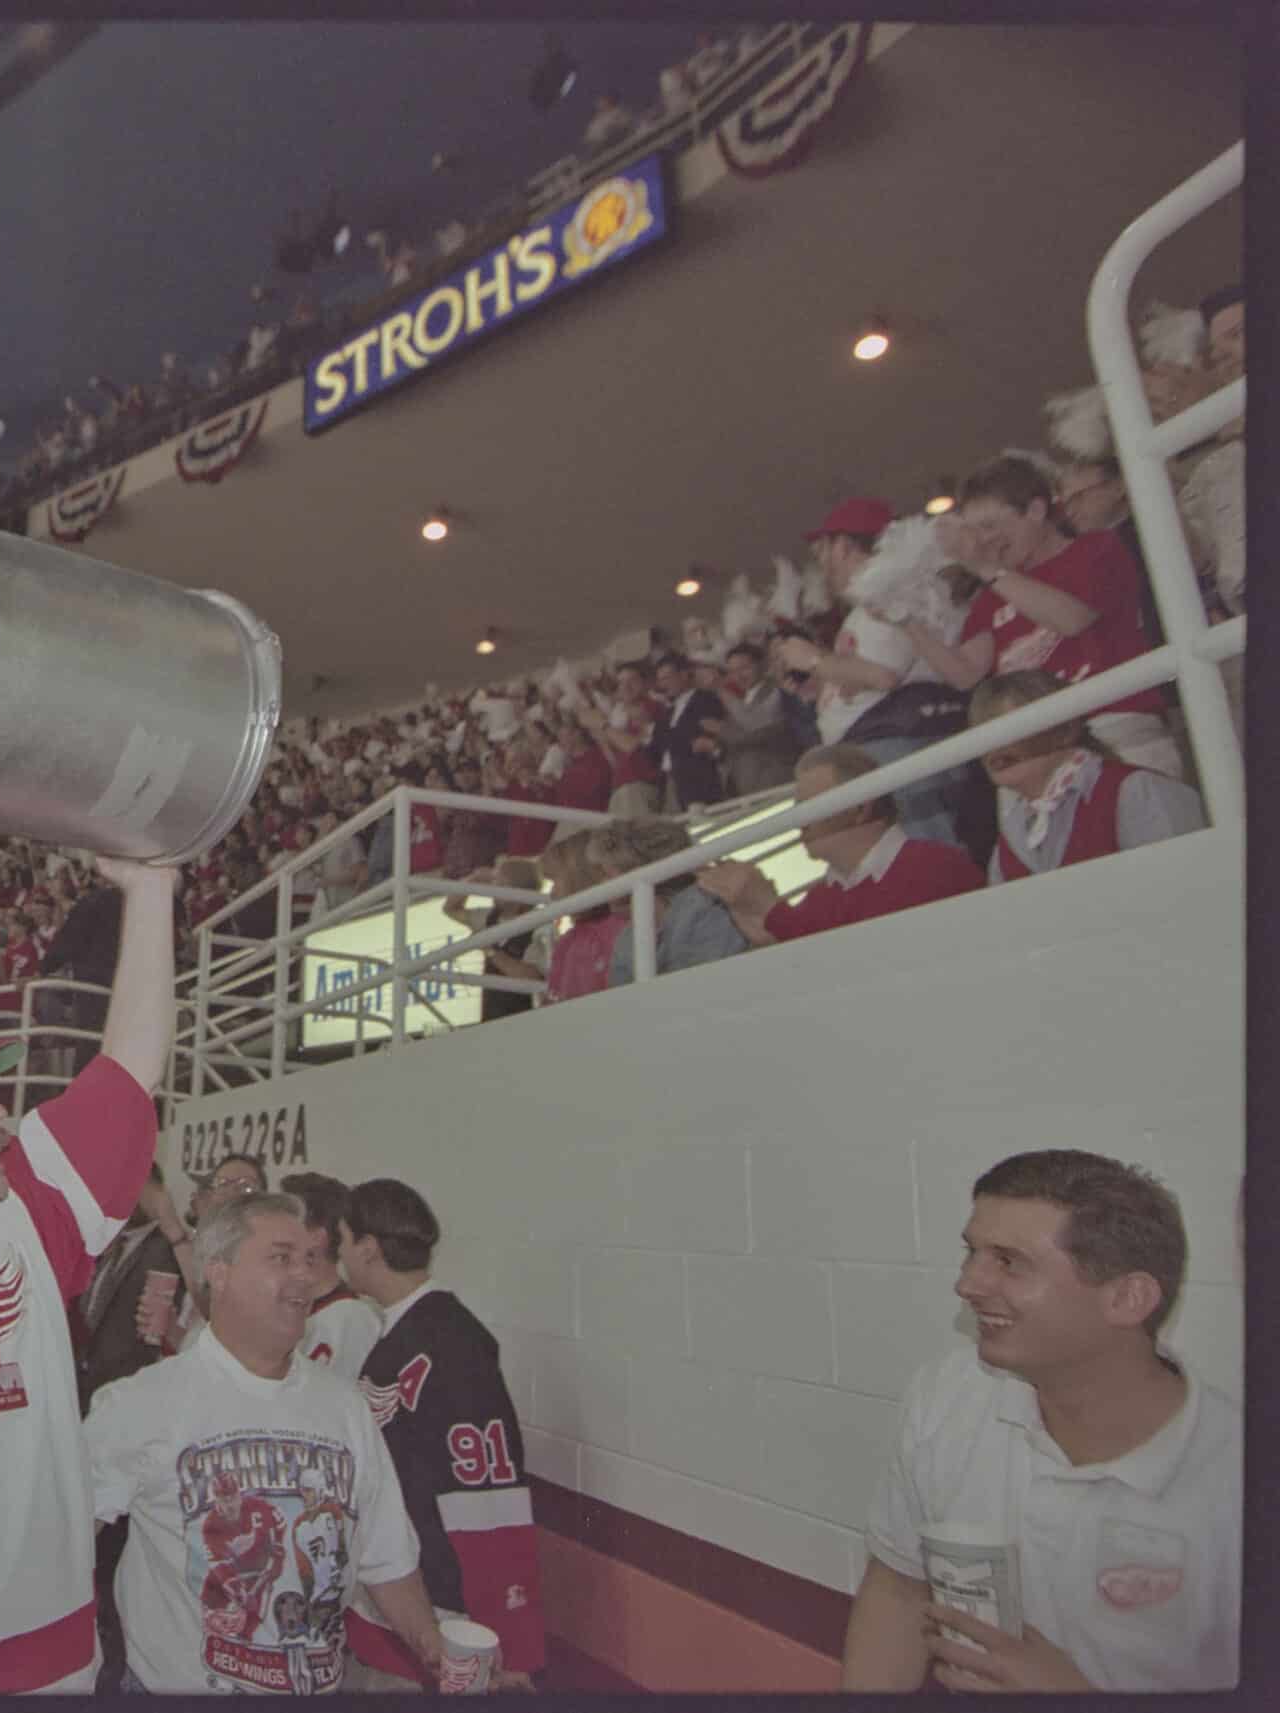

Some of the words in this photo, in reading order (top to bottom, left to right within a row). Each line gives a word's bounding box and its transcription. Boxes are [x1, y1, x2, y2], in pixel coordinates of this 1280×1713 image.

[315, 226, 556, 414] STROH'S
[397, 1353, 431, 1412] A
[178, 1443, 310, 1513] STANLEY
[447, 1419, 517, 1486] 91
[251, 1511, 265, 1529] C
[212, 1650, 240, 1672] RED
[240, 1660, 288, 1686] WINGS
